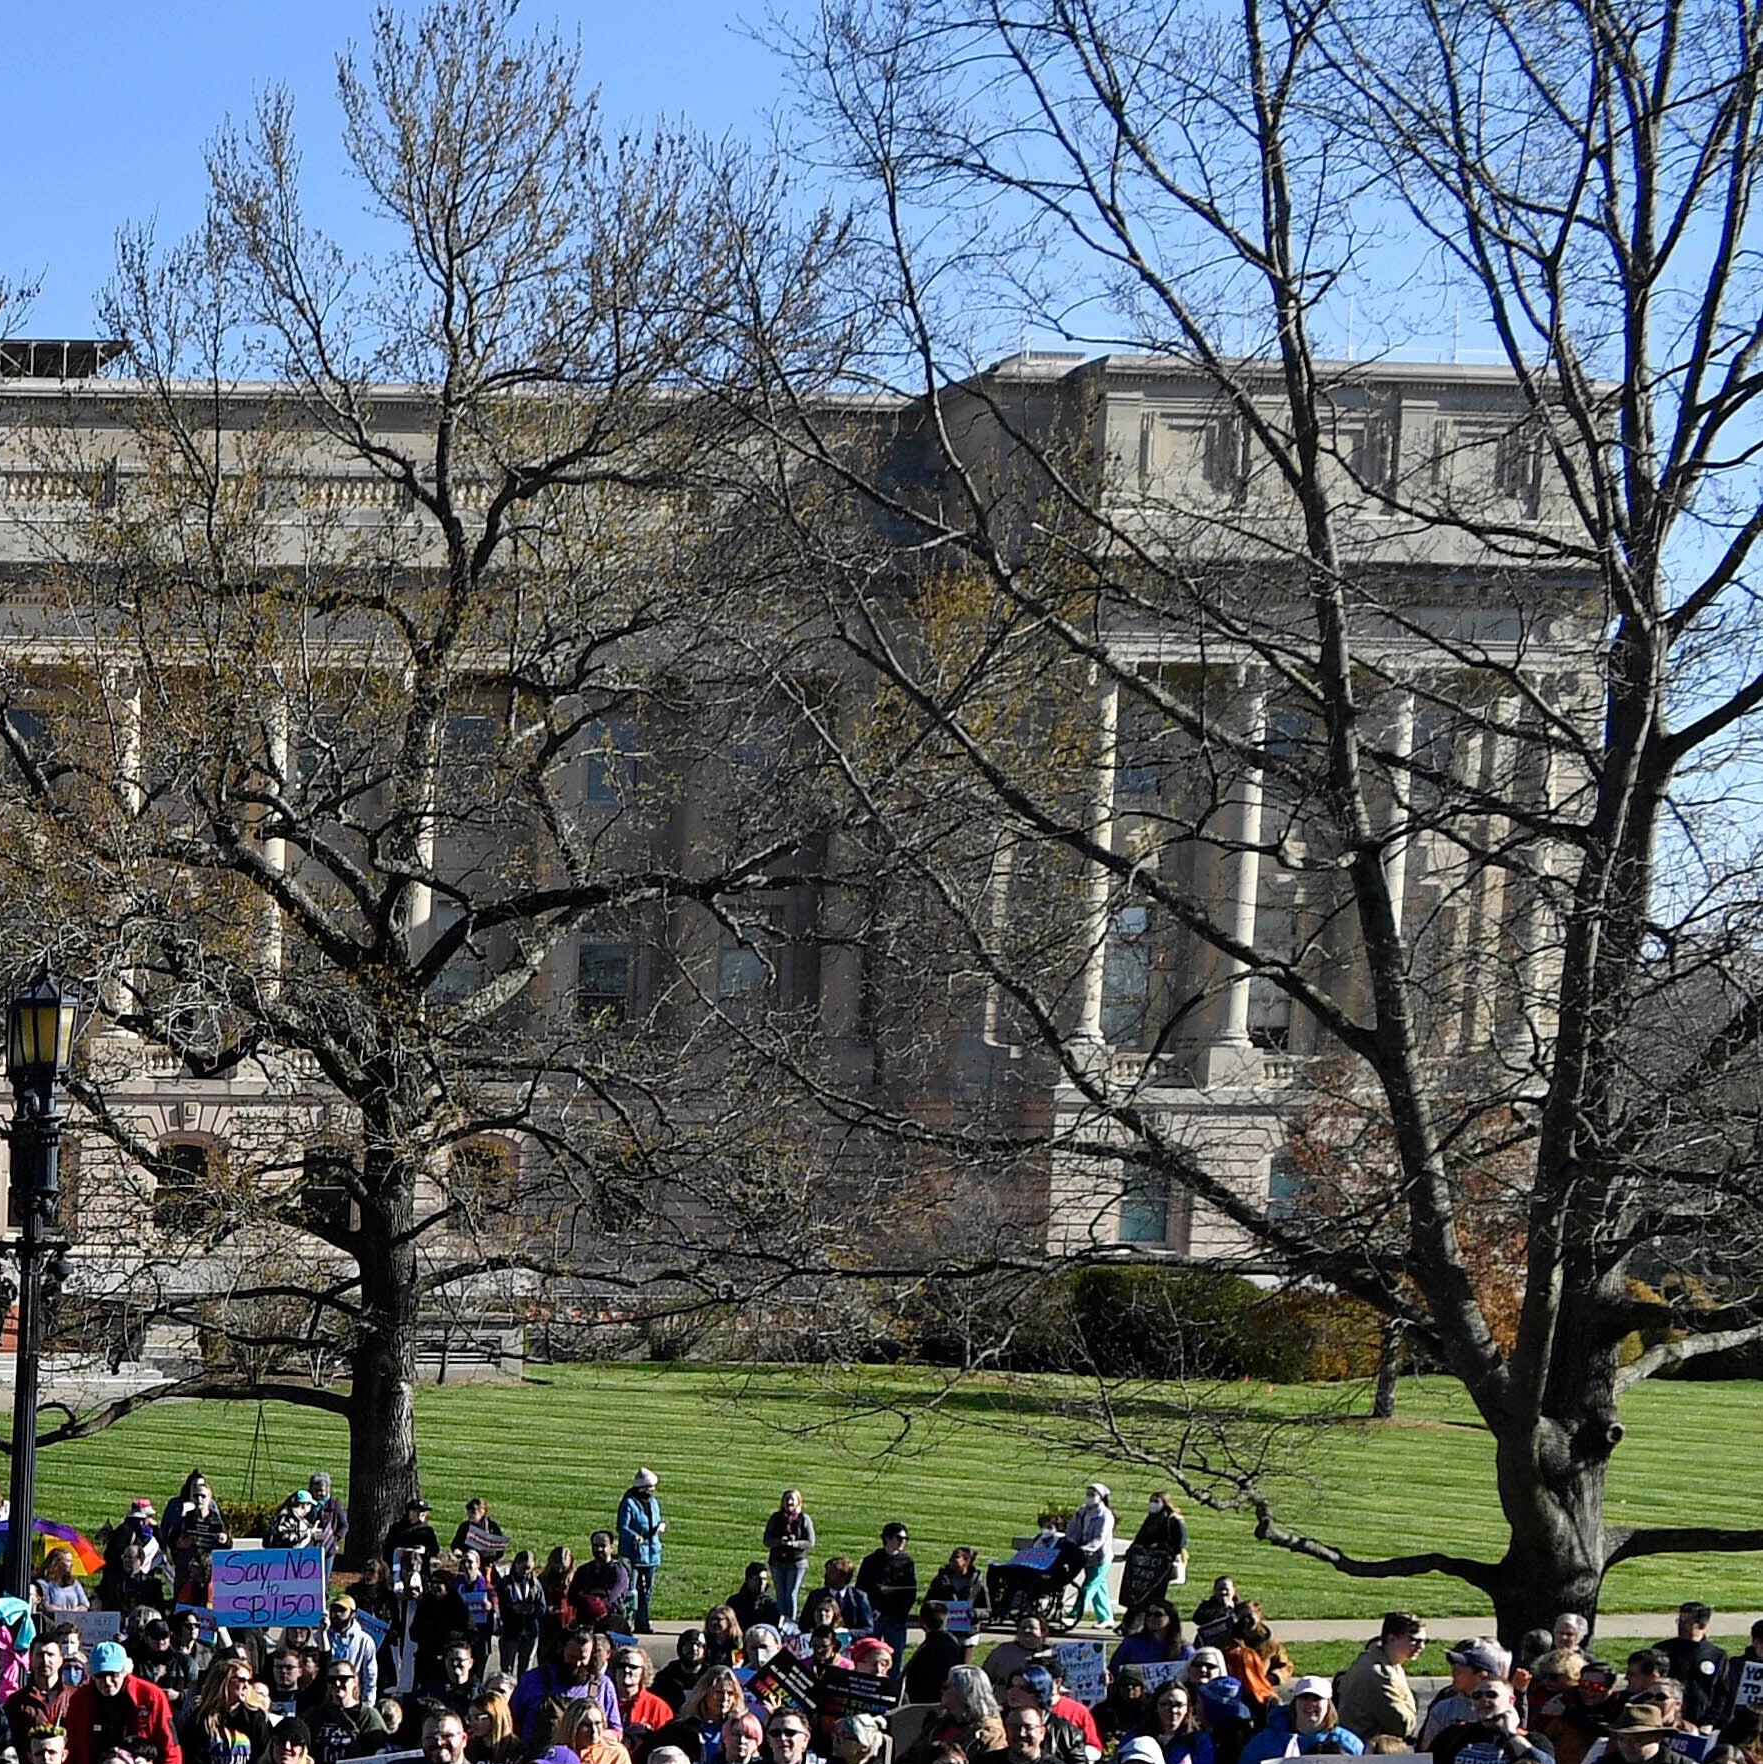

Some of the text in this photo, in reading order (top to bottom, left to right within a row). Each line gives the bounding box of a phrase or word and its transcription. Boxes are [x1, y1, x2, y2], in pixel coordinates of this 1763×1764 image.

[221, 1550, 317, 1590] Say No
[266, 1581, 280, 1596] to
[231, 1596, 316, 1625] SB150
